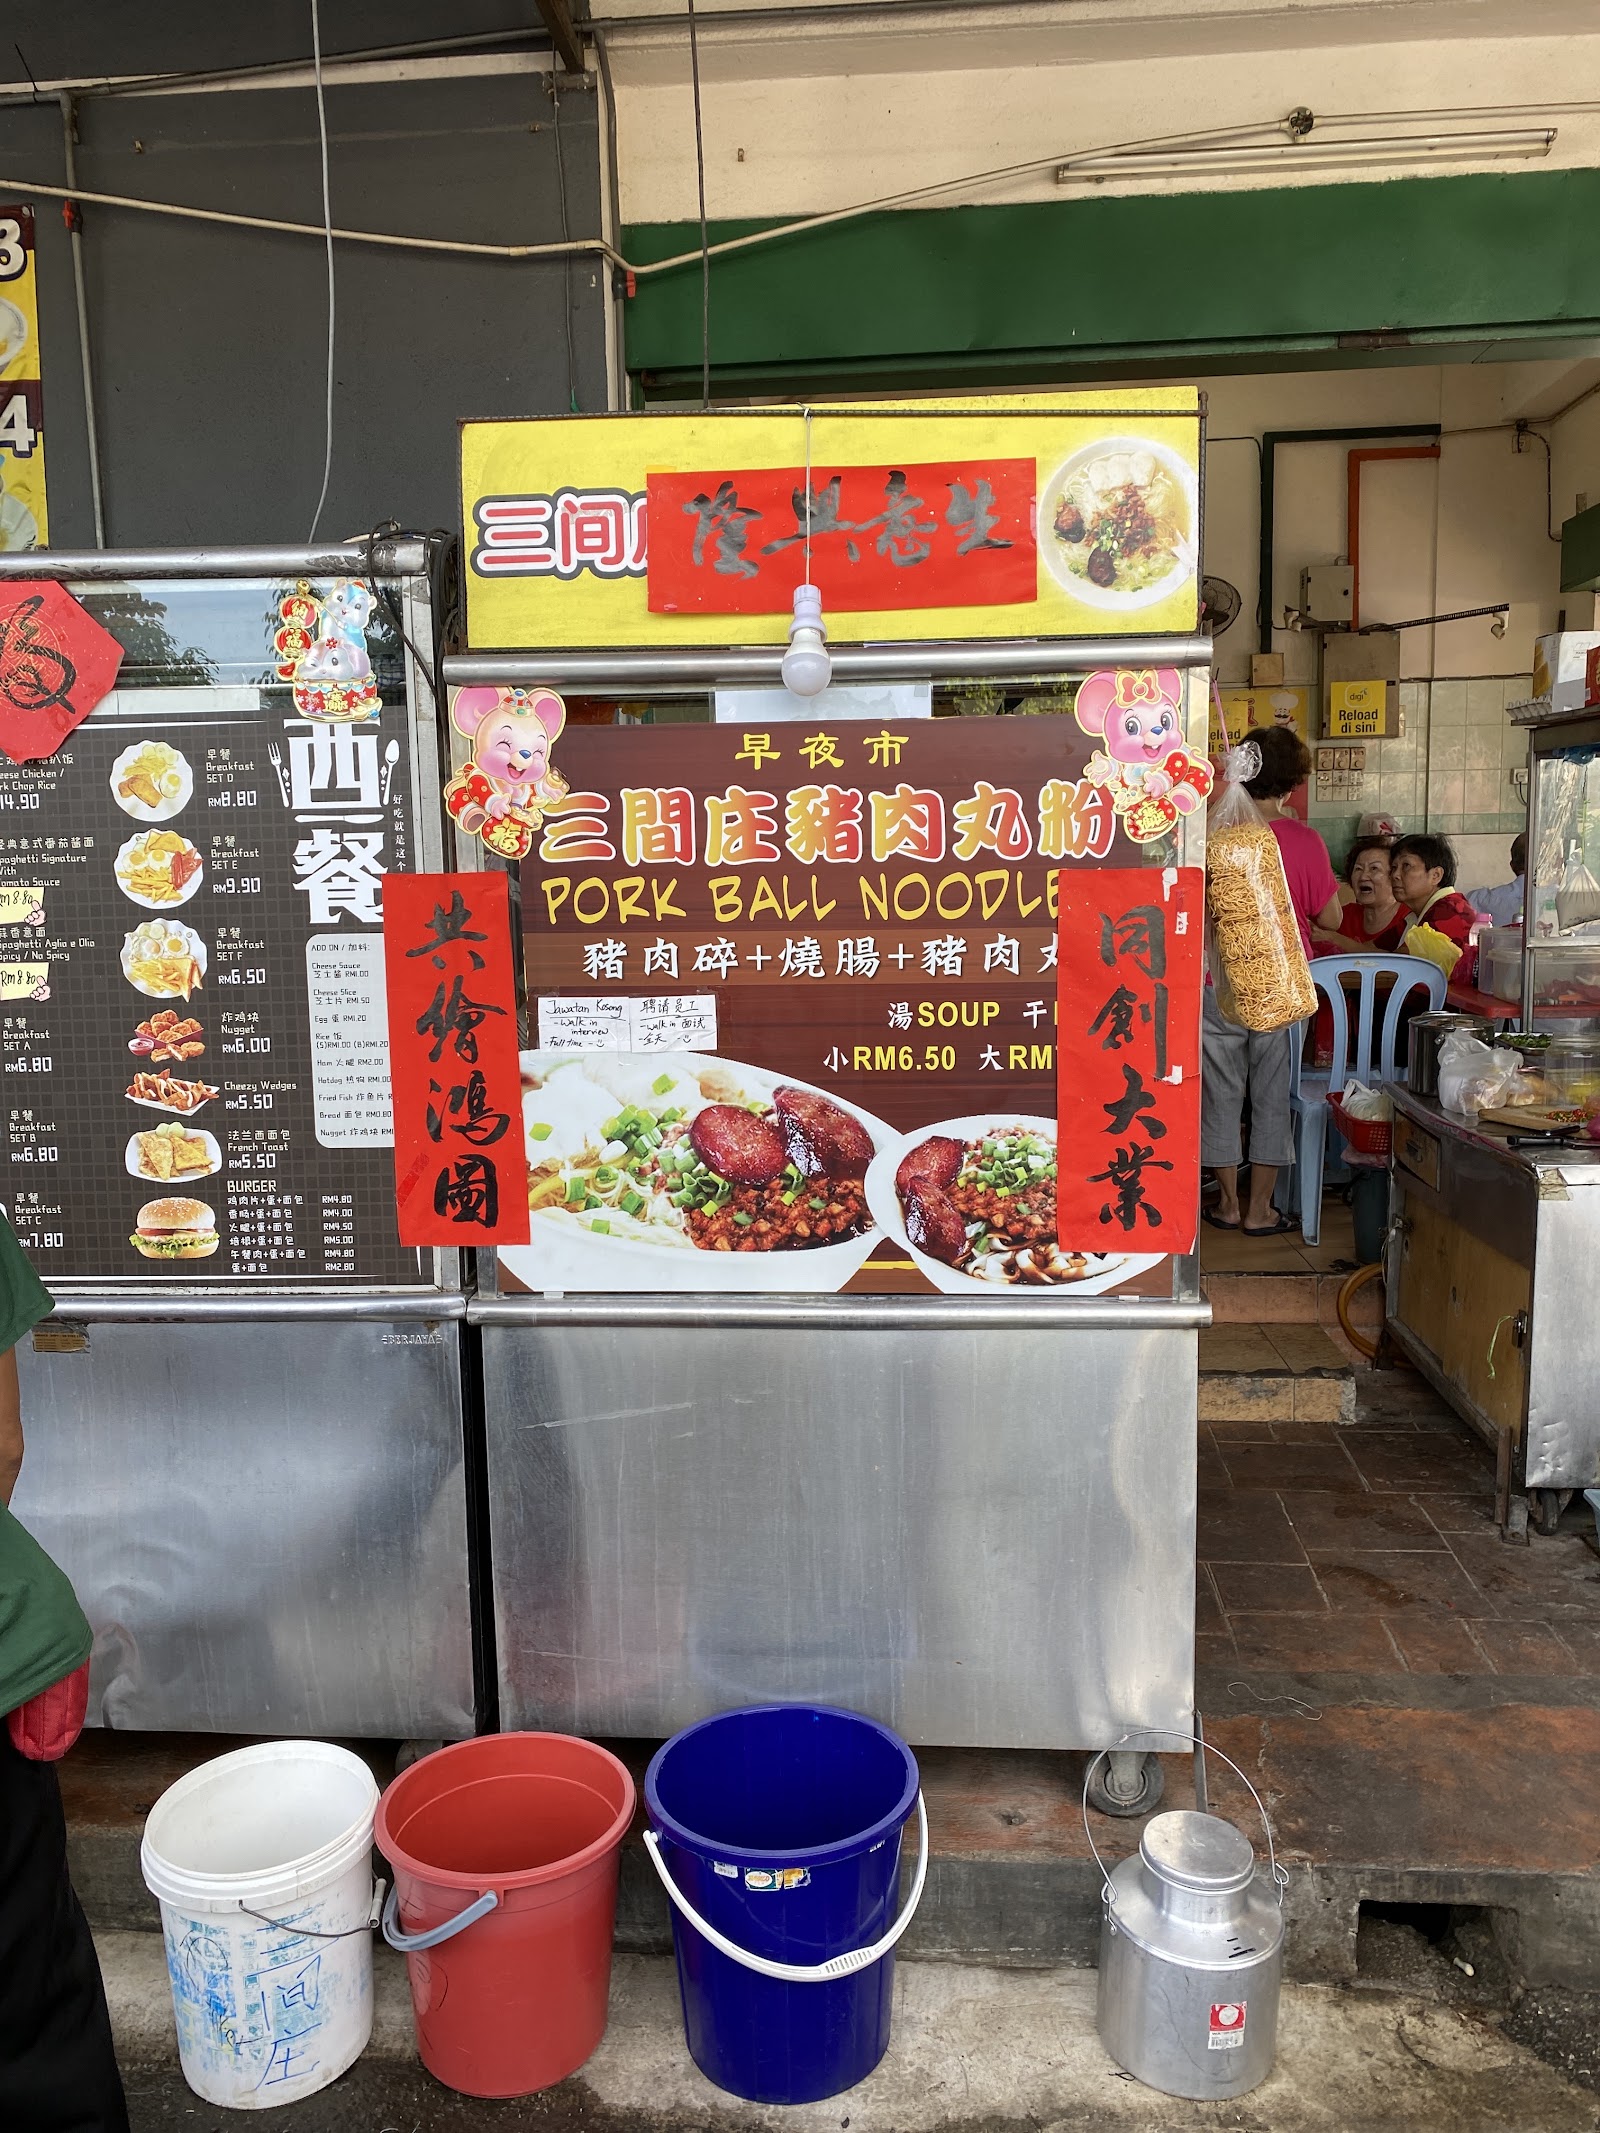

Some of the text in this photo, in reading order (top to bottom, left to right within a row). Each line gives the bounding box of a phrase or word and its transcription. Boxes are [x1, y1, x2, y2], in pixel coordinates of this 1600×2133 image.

[478, 492, 648, 573] 三间
[1339, 709, 1378, 721] Reload
[1341, 721, 1376, 733] di sini
[735, 730, 909, 771] 早夜市
[206, 761, 254, 772] Breakfast
[22, 769, 57, 779] Chicken
[206, 773, 234, 783] SET D
[12, 781, 34, 792] Chop
[37, 780, 56, 790] Rice
[208, 790, 257, 807] RM8.80
[284, 719, 388, 924] 西餐
[211, 848, 259, 858] Breakfast
[42, 853, 87, 865] Signature
[211, 860, 238, 870] SET E
[0, 877, 60, 887] omato Sauce
[212, 877, 261, 894] RM9.90
[541, 876, 687, 924] PORK
[709, 874, 837, 923] BALL
[0, 939, 41, 950] paghetti
[45, 939, 67, 949] Aglio
[79, 938, 95, 948] Olio
[216, 939, 264, 950] Breakfast
[31, 951, 44, 960] No
[46, 950, 70, 961] Spicy
[217, 951, 243, 961] SET F
[218, 968, 266, 985] RM6.50
[545, 999, 590, 1015] Jawatan
[315, 1015, 328, 1023] Egg
[2, 1030, 50, 1040] Breakfast
[221, 1024, 255, 1035] Nugget
[571, 1027, 609, 1036] interview
[3, 1041, 31, 1051] SET A
[222, 1037, 271, 1053] RM6.00
[5, 1056, 52, 1073] RM6.80
[224, 1080, 297, 1092] Cheezy Wedges
[318, 1077, 343, 1085] Hotdog
[225, 1093, 273, 1110] RM5.50
[9, 1122, 56, 1132] Breakfast
[10, 1133, 37, 1143] SET B
[320, 1129, 346, 1137] Nugget
[227, 1141, 288, 1151] French Toast
[11, 1146, 58, 1162] RM6.80
[228, 1153, 276, 1169] RM5.50
[227, 1180, 277, 1193] BURGER
[321, 1195, 352, 1204] RM4.80
[14, 1204, 62, 1214] Breakfast
[322, 1208, 353, 1217] RM4.00
[15, 1216, 42, 1225] SET C
[323, 1222, 353, 1231] RM4.50
[323, 1235, 354, 1244] RM5.00
[324, 1249, 354, 1258] RM4.80
[325, 1262, 354, 1271] RM2.80
